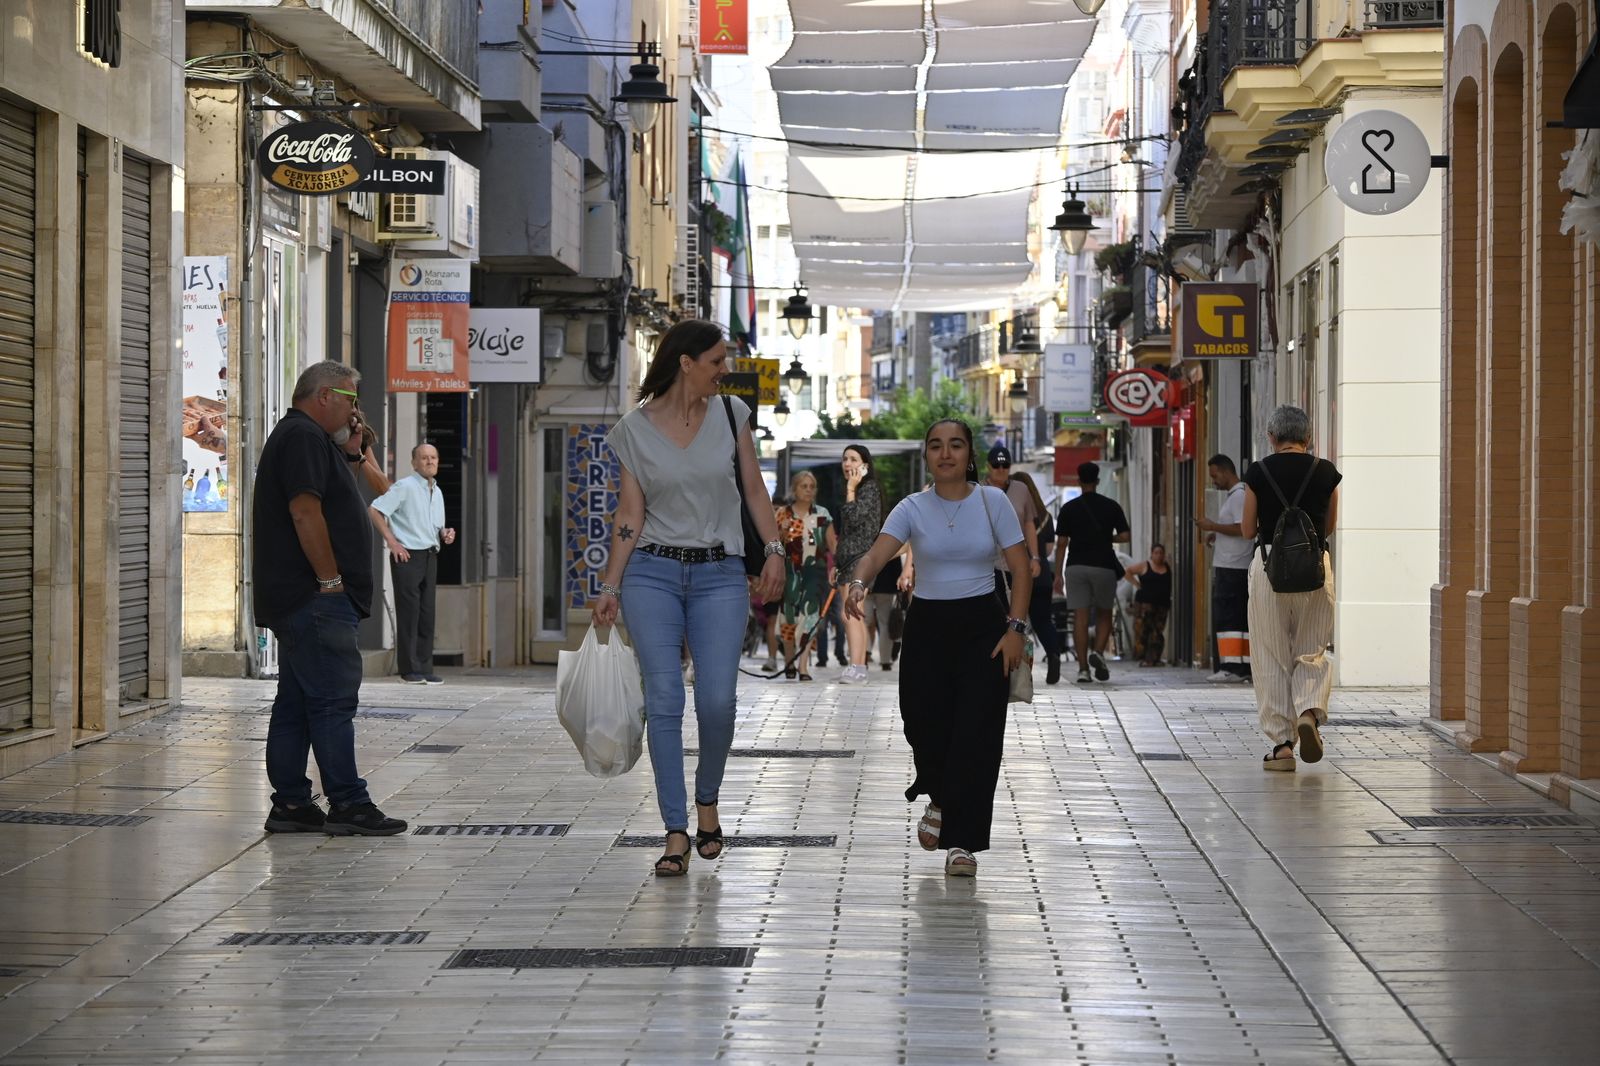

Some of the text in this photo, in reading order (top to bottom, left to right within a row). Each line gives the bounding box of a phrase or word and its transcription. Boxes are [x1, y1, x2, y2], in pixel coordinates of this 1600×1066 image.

[268, 133, 354, 164] Coca-Cola
[284, 168, 349, 183] CERVECERIA
[287, 177, 346, 190] XCAJONES
[424, 269, 460, 278] Manzana
[424, 278, 442, 286] Rota
[392, 290, 467, 302] SERVICIO TÉCNICO
[409, 326, 440, 335] LISTO EN
[413, 336, 422, 364] 1
[424, 336, 433, 364] HORA
[1193, 343, 1249, 355] TABACOS
[391, 378, 466, 390] Móviles y Tablets
[584, 435, 609, 598] TREBOL
